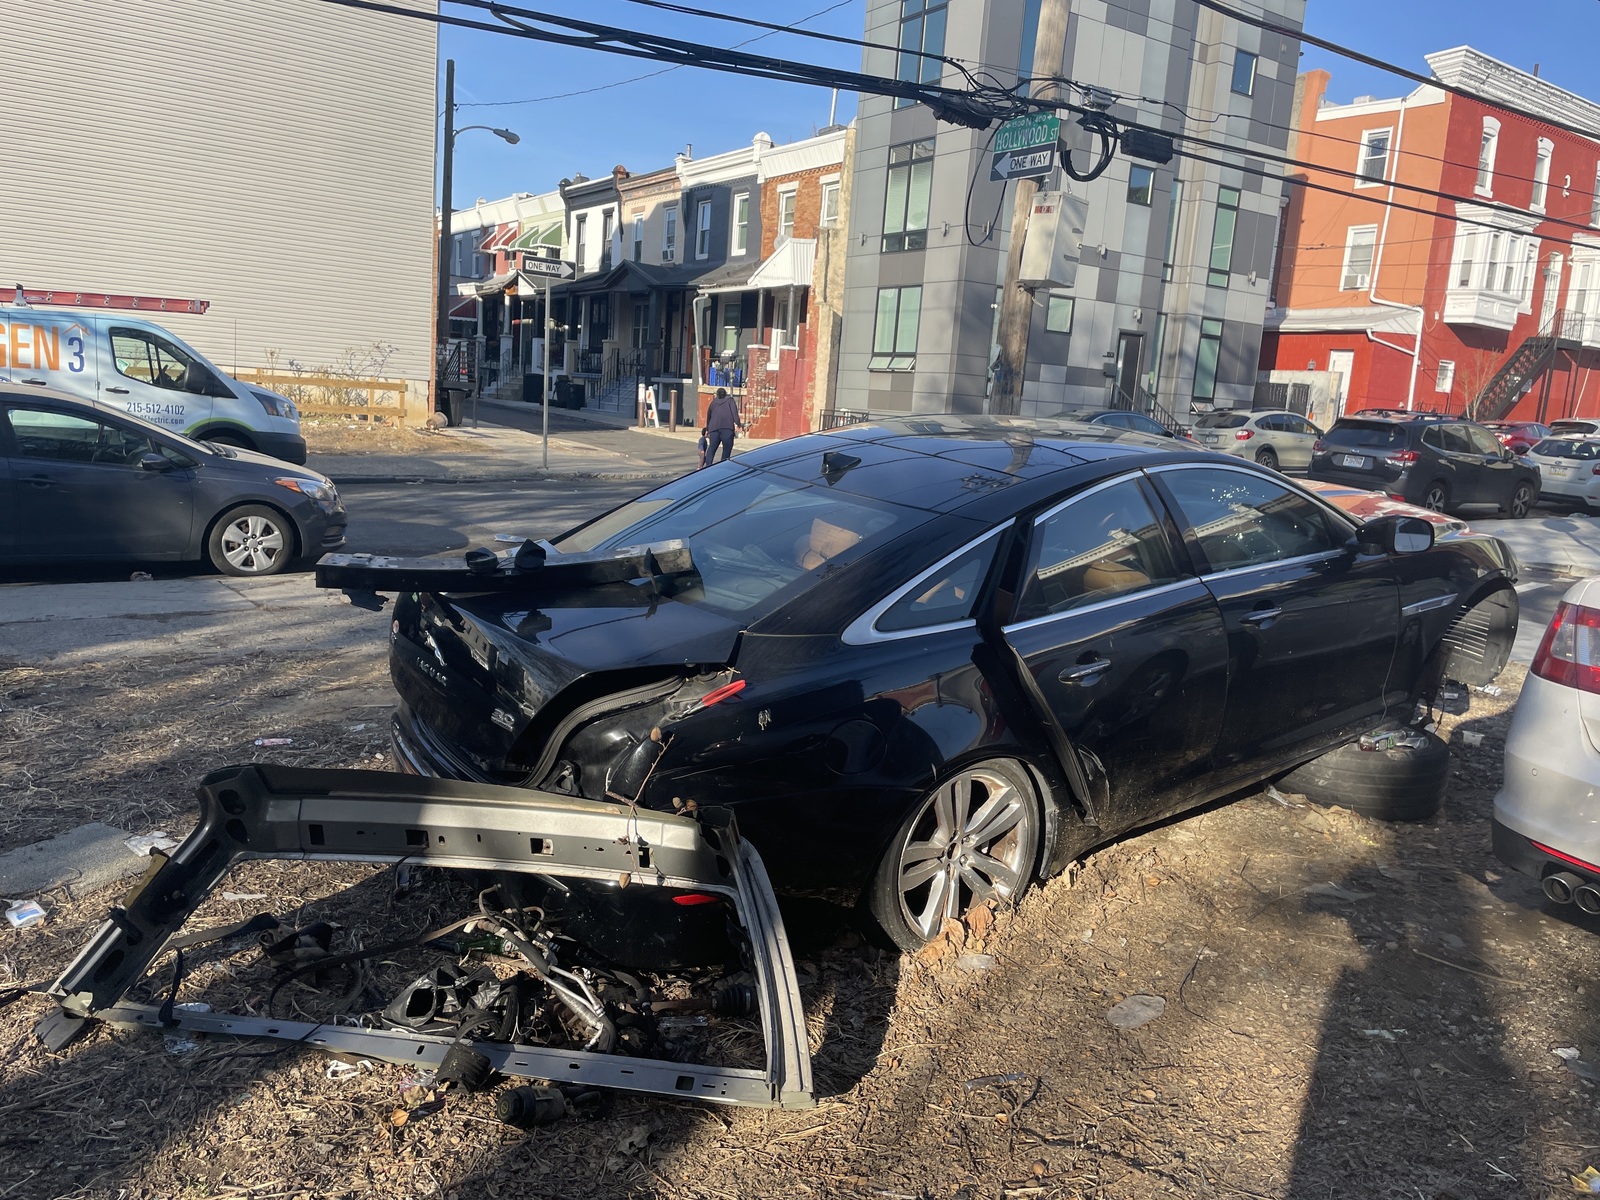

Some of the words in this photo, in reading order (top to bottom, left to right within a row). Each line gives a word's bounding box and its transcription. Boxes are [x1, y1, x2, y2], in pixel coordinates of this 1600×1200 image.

[995, 124, 1048, 151] HOLLYWOOD
[1050, 127, 1058, 140] ST
[1010, 156, 1027, 170] ONE
[1030, 152, 1048, 167] WAY
[528, 261, 543, 271] ONE
[545, 264, 560, 273] WAY
[67, 336, 85, 373] 3
[126, 401, 185, 416] 215-512-4102
